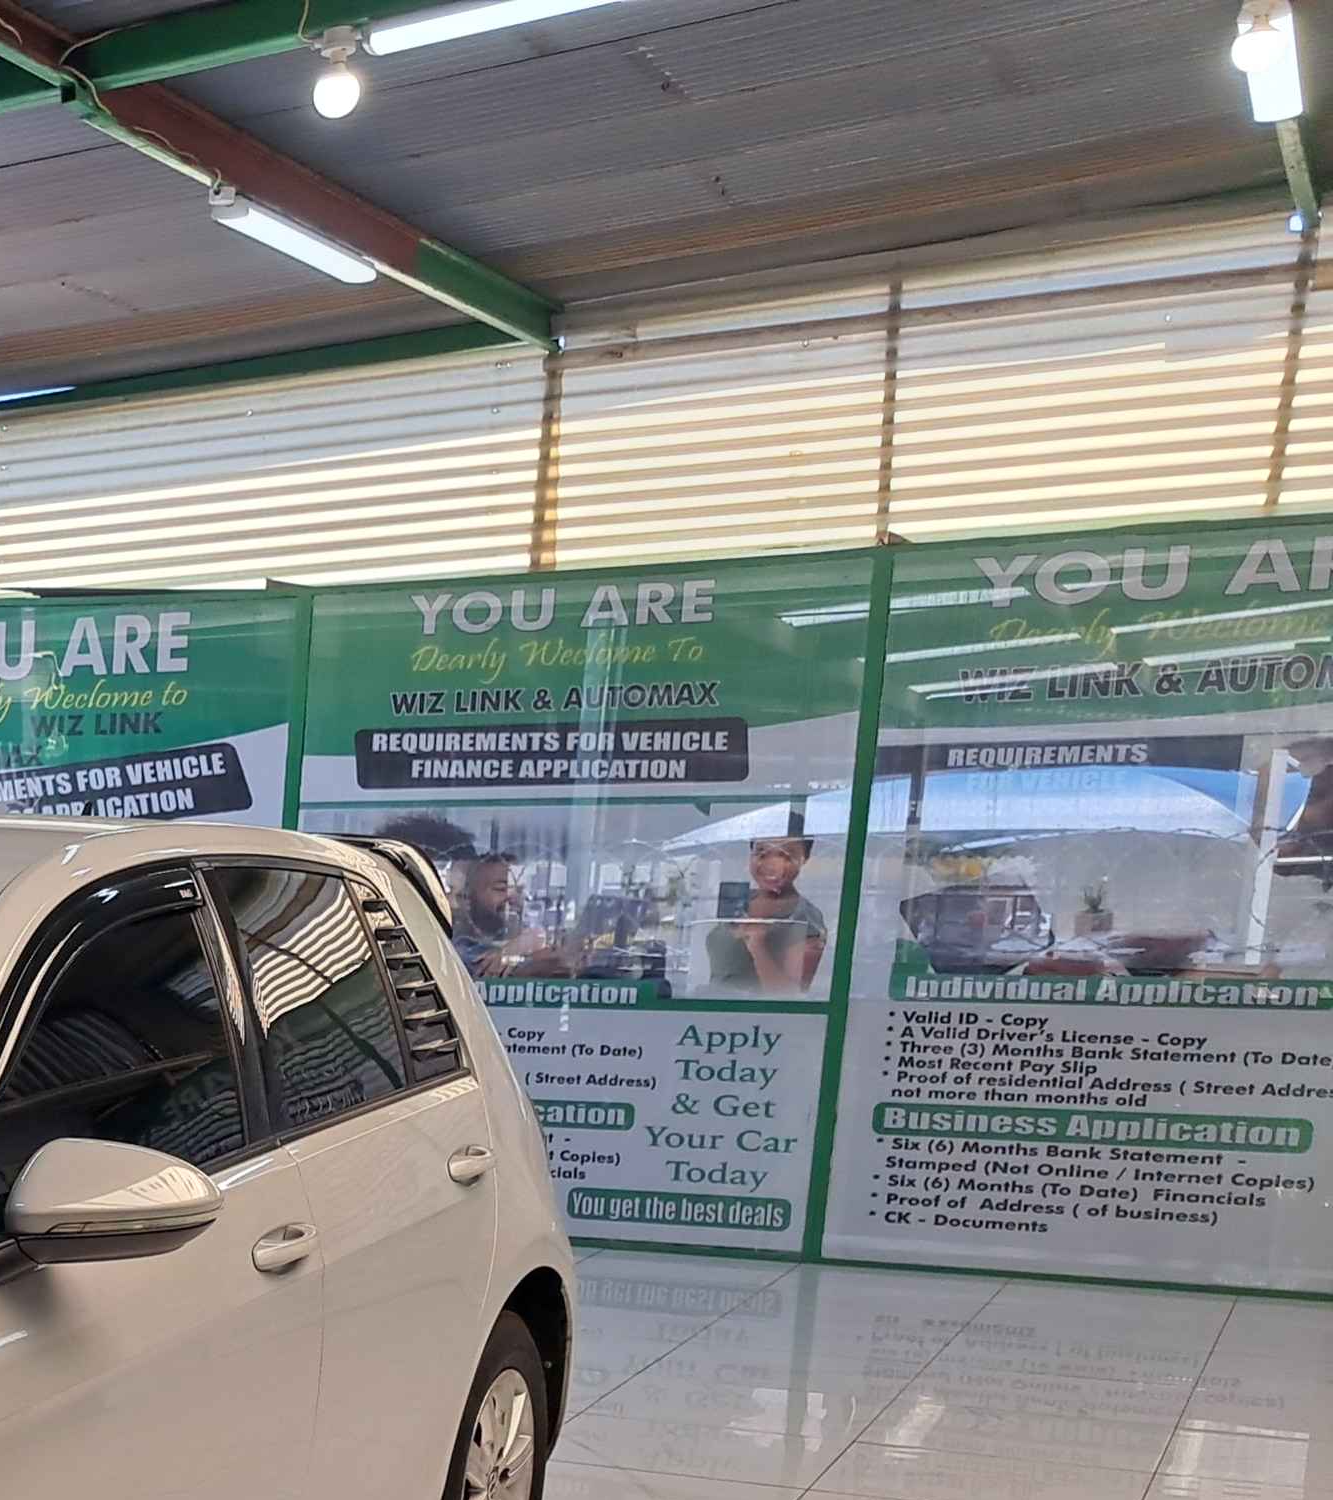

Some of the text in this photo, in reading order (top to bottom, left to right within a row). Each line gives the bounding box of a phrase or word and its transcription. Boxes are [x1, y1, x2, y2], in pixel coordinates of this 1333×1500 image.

[973, 545, 1192, 608] YOU
[411, 579, 717, 635] YOU ARE
[61, 612, 191, 676] ARE
[410, 637, 508, 684] Dearly
[669, 636, 704, 662] To
[162, 681, 187, 706] to
[1046, 662, 1144, 700] LINK
[1154, 663, 1182, 697] &
[390, 680, 721, 716] WIZ LINK & AUTOMAX
[31, 712, 164, 737] WIZ LINK
[371, 730, 729, 753] REQUIREMENTS FOR VEHICLE
[947, 743, 1149, 768] REQUIREMENTS
[77, 766, 122, 792] FOR
[124, 752, 226, 784] VEHICLE
[411, 757, 686, 780] FINANCE APPLICATION
[41, 788, 194, 818] APPICATION
[905, 975, 1319, 1007] Individual Application
[507, 1027, 545, 1042] Copy
[903, 1011, 952, 1025] Valid
[958, 1012, 978, 1026] ID
[1001, 1013, 1049, 1030] Copy
[504, 1044, 643, 1060] atement (To Date)
[677, 1024, 782, 1053] Apply
[900, 1026, 914, 1039] A
[921, 1026, 969, 1041] Valid
[1061, 1030, 1134, 1045] License
[1158, 1033, 1207, 1050] Copy
[897, 1056, 1098, 1077] Most Recent Pay Slip
[900, 1041, 954, 1056] Three
[992, 1044, 1063, 1059] Months
[1071, 1046, 1123, 1061] Bank
[1130, 1047, 1236, 1064] Statement
[1281, 1052, 1333, 1068] Date
[535, 1072, 582, 1086] Street
[585, 1074, 657, 1090] Address)
[675, 1059, 780, 1090] Today
[897, 1070, 948, 1085] Proof
[953, 1072, 972, 1086] of
[977, 1074, 1083, 1090] residential
[1090, 1076, 1172, 1093] Address
[1193, 1080, 1255, 1097] Street
[671, 1093, 776, 1119] & Get
[891, 1087, 1147, 1108] not more than months old
[534, 1104, 626, 1126] cation
[883, 1107, 1301, 1148] Business Application
[645, 1126, 798, 1154] Your Car
[891, 1137, 921, 1151] Six
[928, 1139, 954, 1156] (6)
[961, 1141, 1038, 1158] Months
[1046, 1144, 1101, 1160] Bank
[1109, 1147, 1223, 1166] Statement
[665, 1160, 769, 1193] Today
[885, 1156, 977, 1174] Stamped
[1037, 1163, 1109, 1181] Online
[1133, 1168, 1223, 1186] Internet
[887, 1174, 917, 1189] Six
[956, 1178, 1034, 1195] Months
[1079, 1184, 1138, 1202] Date)
[1153, 1188, 1266, 1207] Financials
[572, 1191, 784, 1228] You get the best deals
[884, 1211, 912, 1225] CK
[934, 1214, 1049, 1233] Documents
[886, 1193, 941, 1208] Proof
[947, 1196, 967, 1210] of
[979, 1198, 1065, 1215] Address
[1087, 1204, 1109, 1217] of
[1115, 1205, 1218, 1227] business)
